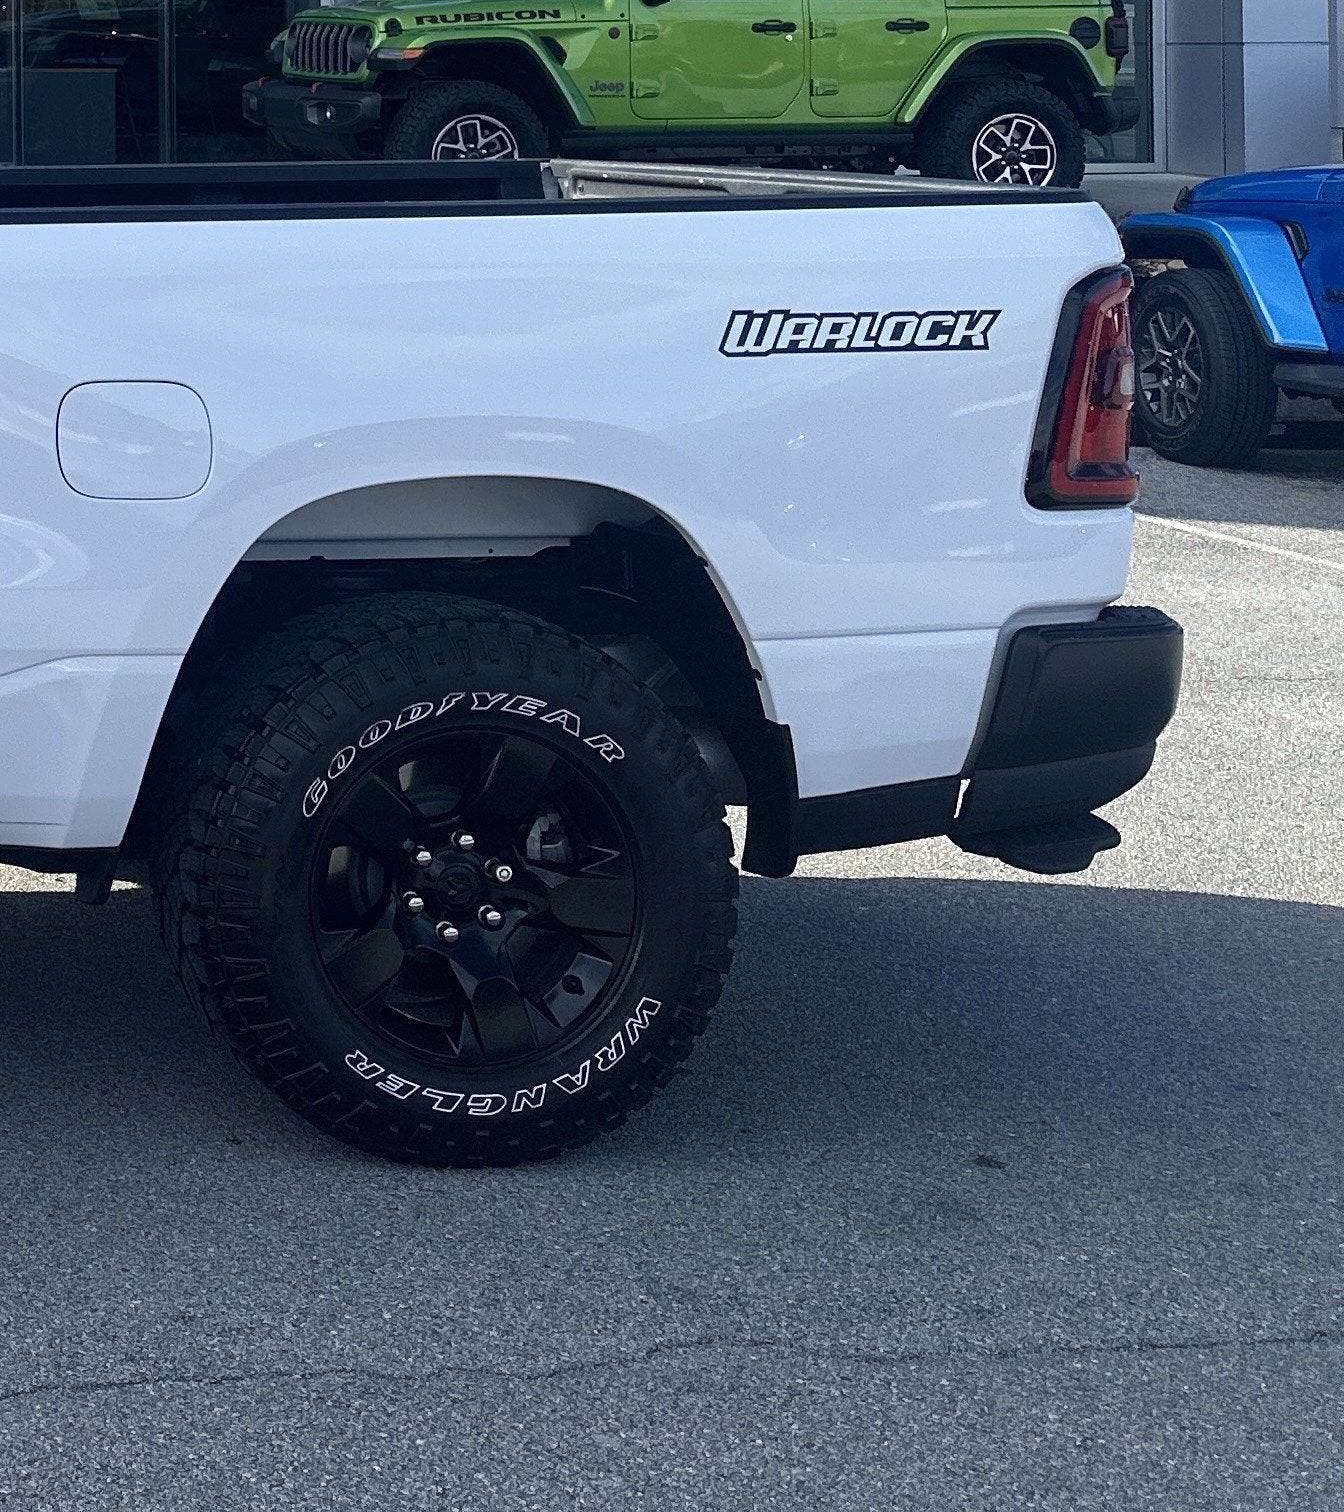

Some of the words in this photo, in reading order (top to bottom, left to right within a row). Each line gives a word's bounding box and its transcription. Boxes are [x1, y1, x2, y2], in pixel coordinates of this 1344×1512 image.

[415, 9, 562, 26] RUBICON
[589, 80, 625, 93] Jeep
[718, 309, 1002, 357] WARLOCK
[302, 692, 626, 818] GOODYEAR
[344, 996, 662, 1115] WRANGLER
